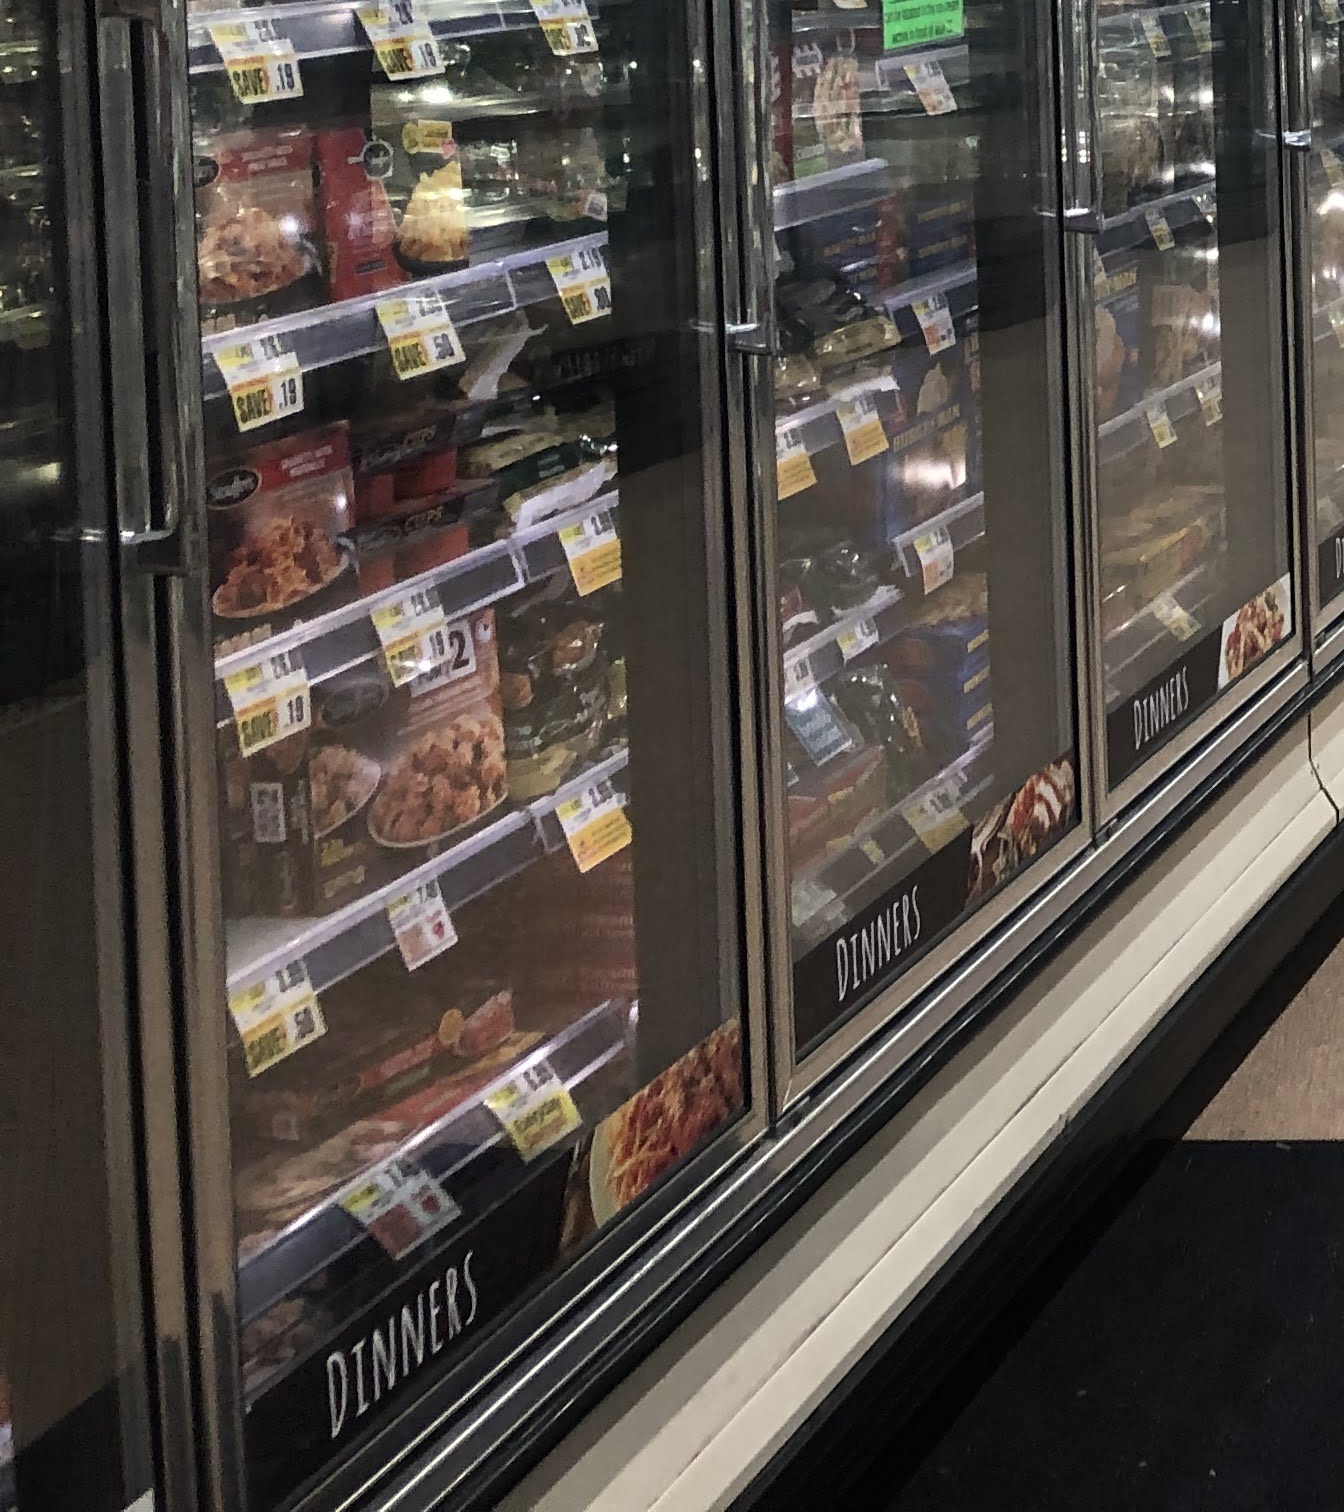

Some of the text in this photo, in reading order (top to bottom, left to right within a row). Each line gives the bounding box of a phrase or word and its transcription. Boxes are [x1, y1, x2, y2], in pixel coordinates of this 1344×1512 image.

[1133, 666, 1189, 750] DINNERS
[836, 885, 921, 1002] DINNERS
[326, 1250, 479, 1439] DINNERS
